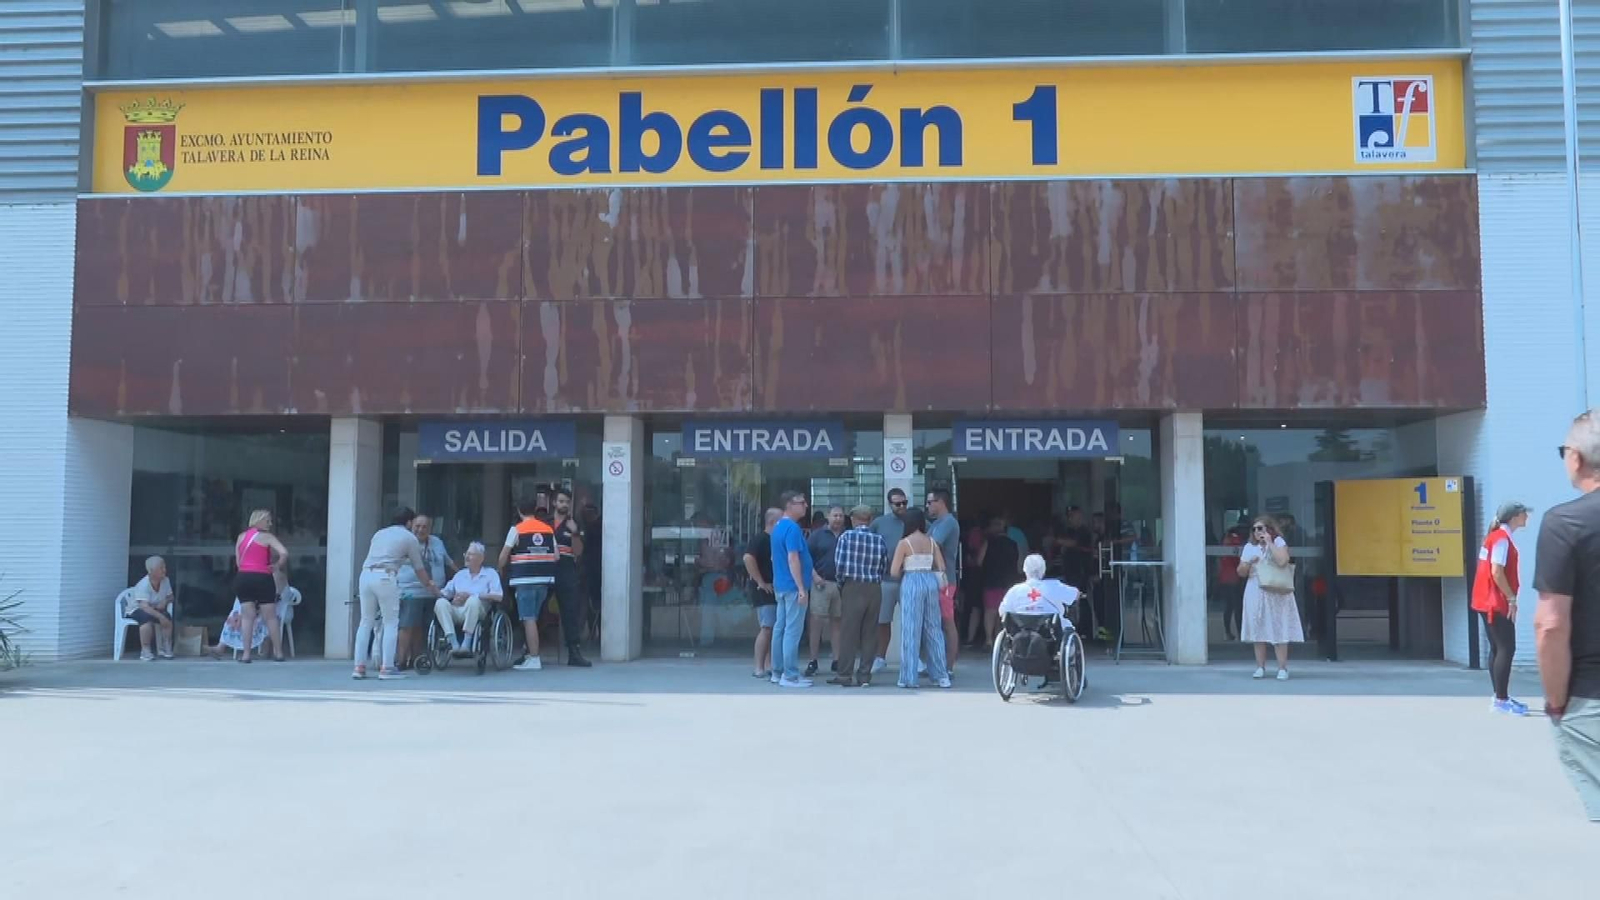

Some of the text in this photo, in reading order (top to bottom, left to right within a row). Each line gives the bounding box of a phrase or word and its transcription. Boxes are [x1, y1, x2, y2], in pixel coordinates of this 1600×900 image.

[180, 131, 333, 148] EXCMO. AYUNTAMIENTO
[476, 84, 1058, 176] Pabellón 1
[181, 147, 330, 164] TALAVERA DE LA REINA
[1360, 150, 1407, 159] talavera
[444, 429, 547, 453] SALIDA
[694, 429, 834, 451] ENTRADA
[965, 427, 1109, 451] ENTRADA
[1413, 481, 1427, 504] 1
